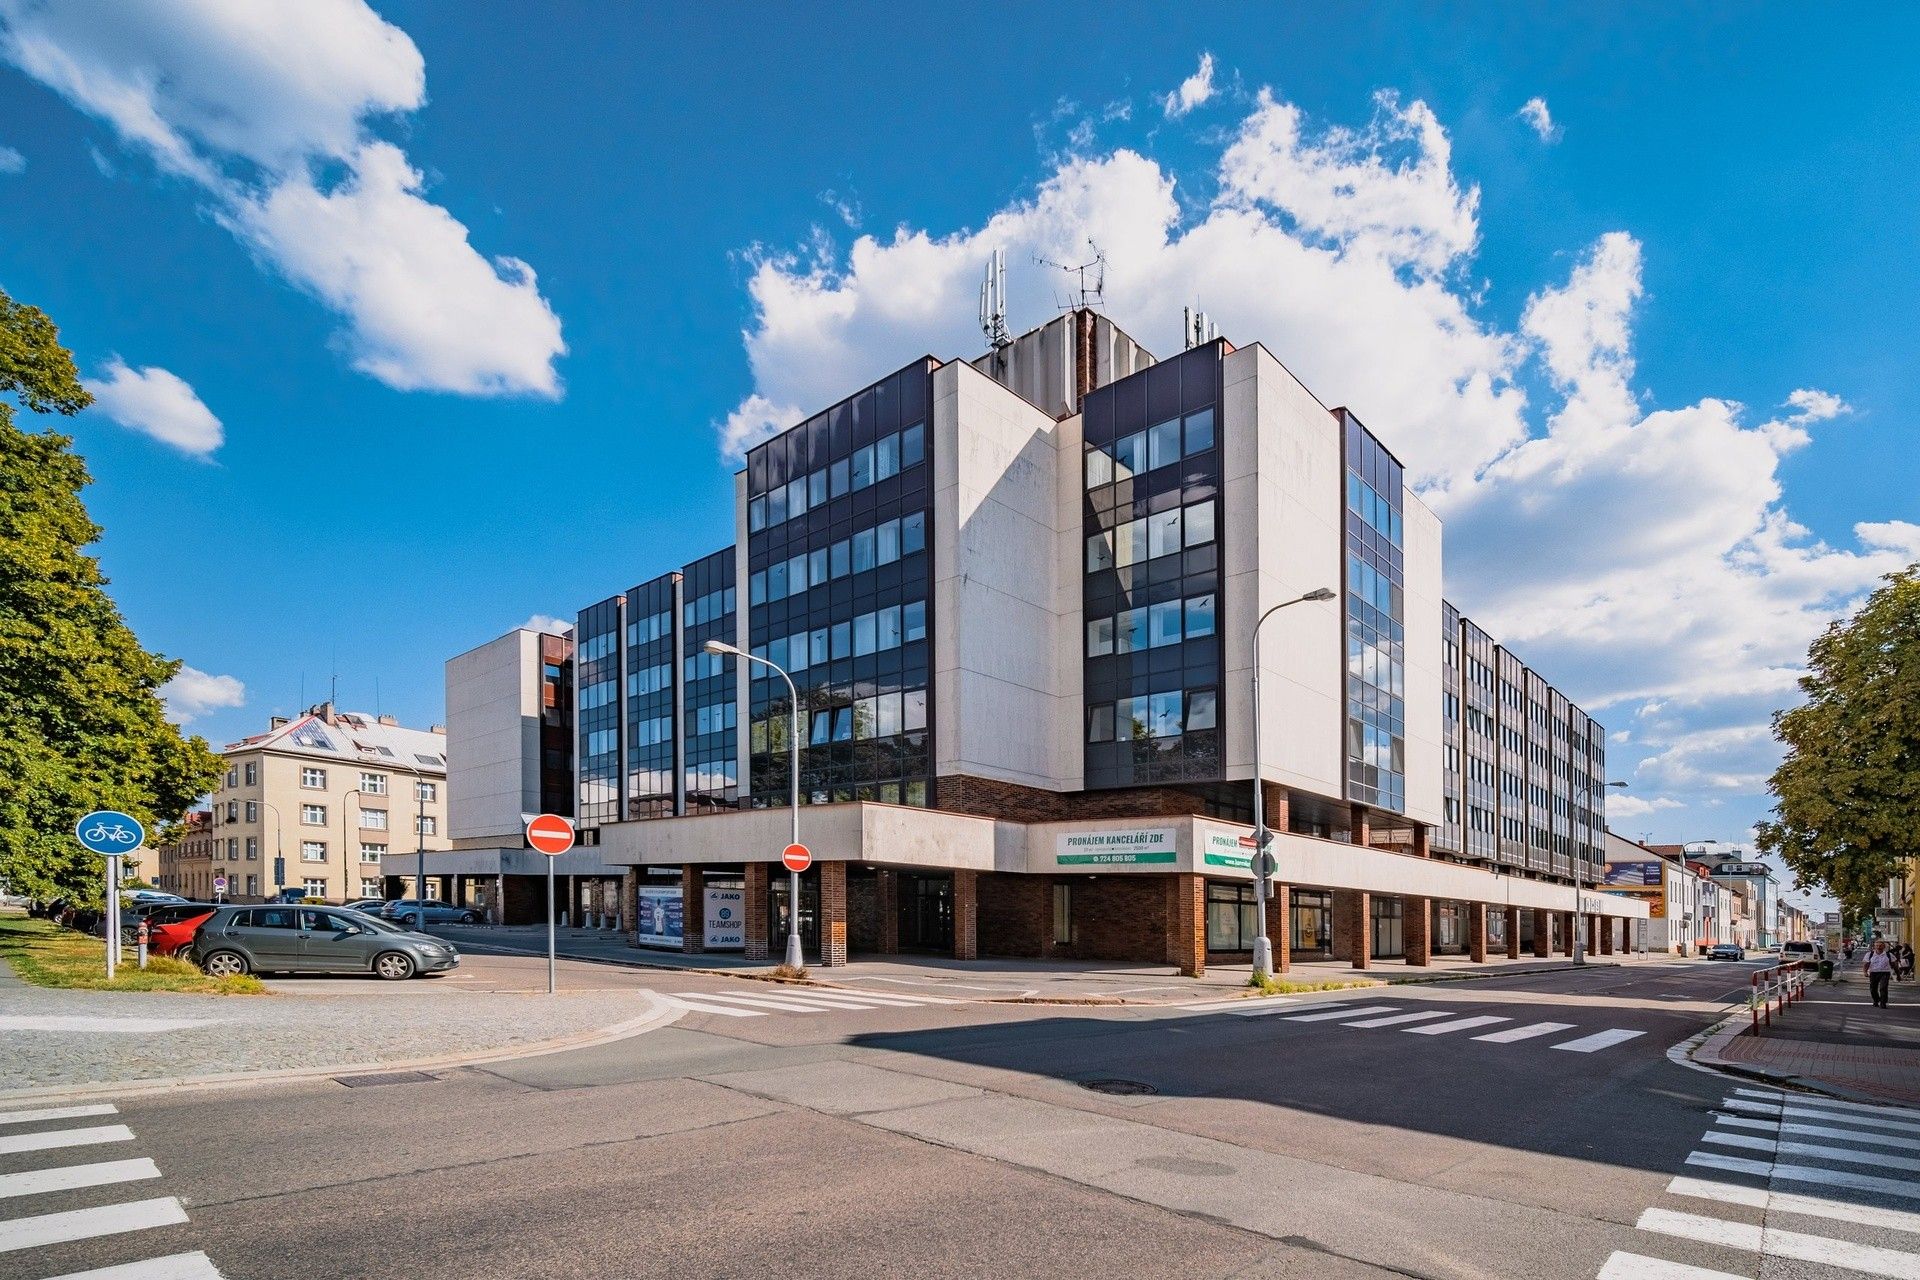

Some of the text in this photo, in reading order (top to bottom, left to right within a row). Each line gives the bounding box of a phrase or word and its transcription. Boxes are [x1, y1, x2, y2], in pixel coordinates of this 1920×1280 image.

[1067, 832, 1163, 846] PRONÁJEM KANCELÁŘÍ ZDE
[709, 920, 742, 929] TEAMSHOP
